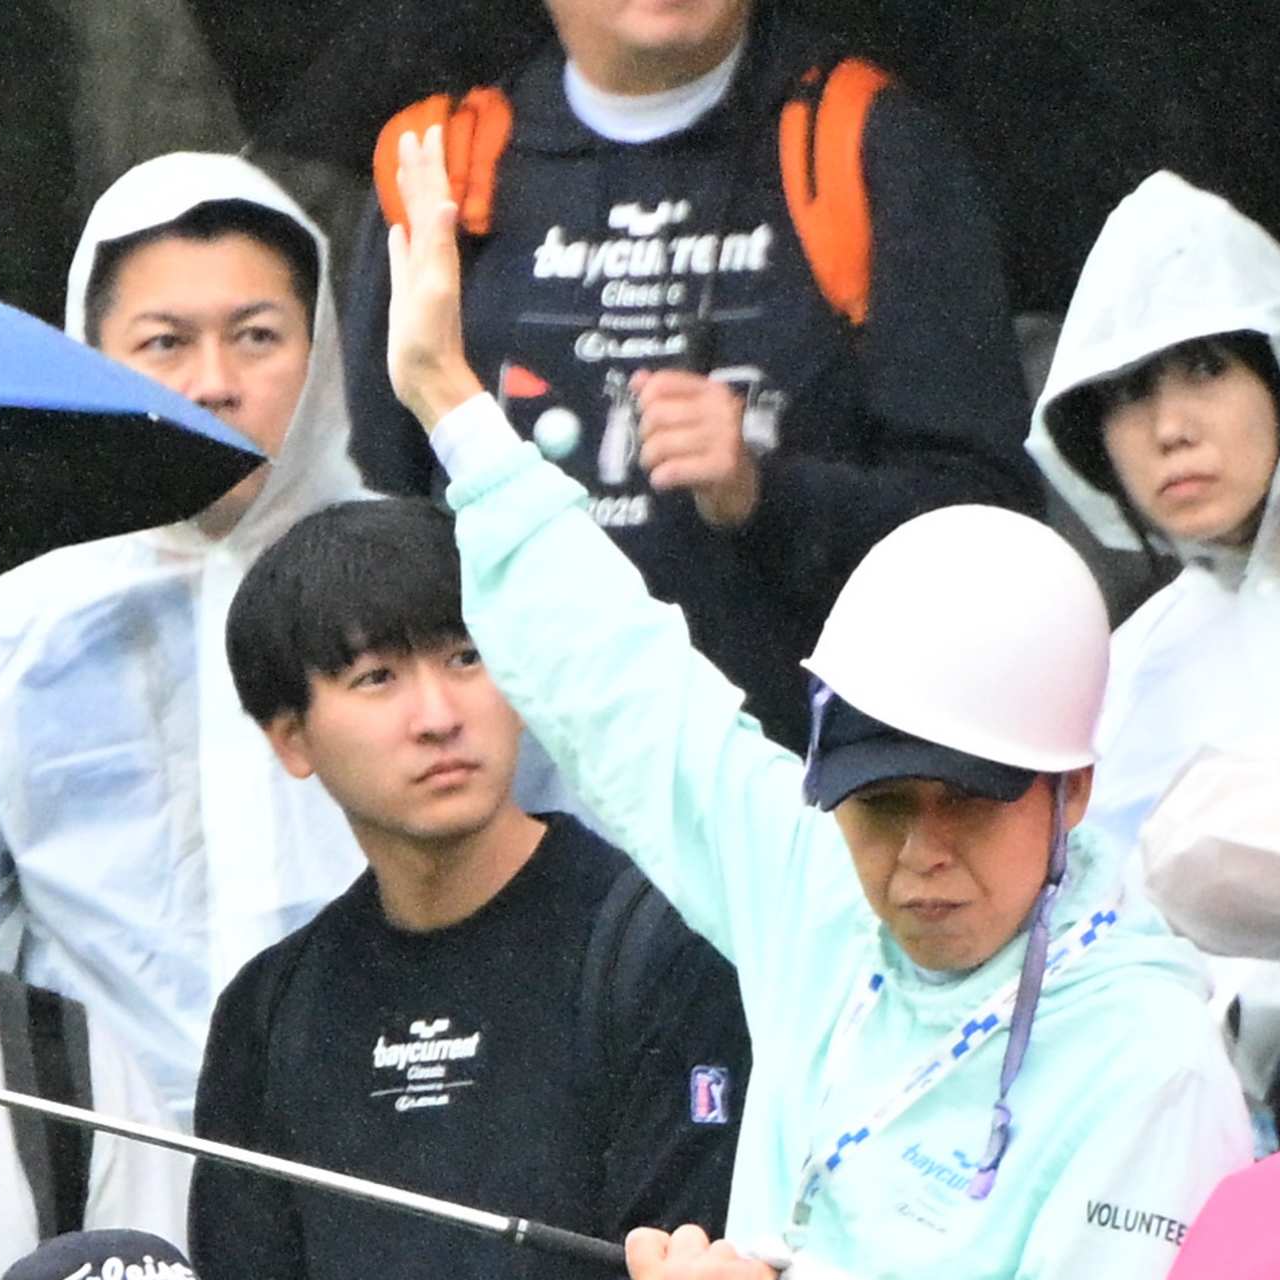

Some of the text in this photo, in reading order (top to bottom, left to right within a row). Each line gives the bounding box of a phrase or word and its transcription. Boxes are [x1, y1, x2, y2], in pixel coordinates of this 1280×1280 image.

[532, 224, 773, 288] baycurent
[601, 280, 686, 308] Classc
[1086, 1199, 1189, 1247] VOLUNTEE
